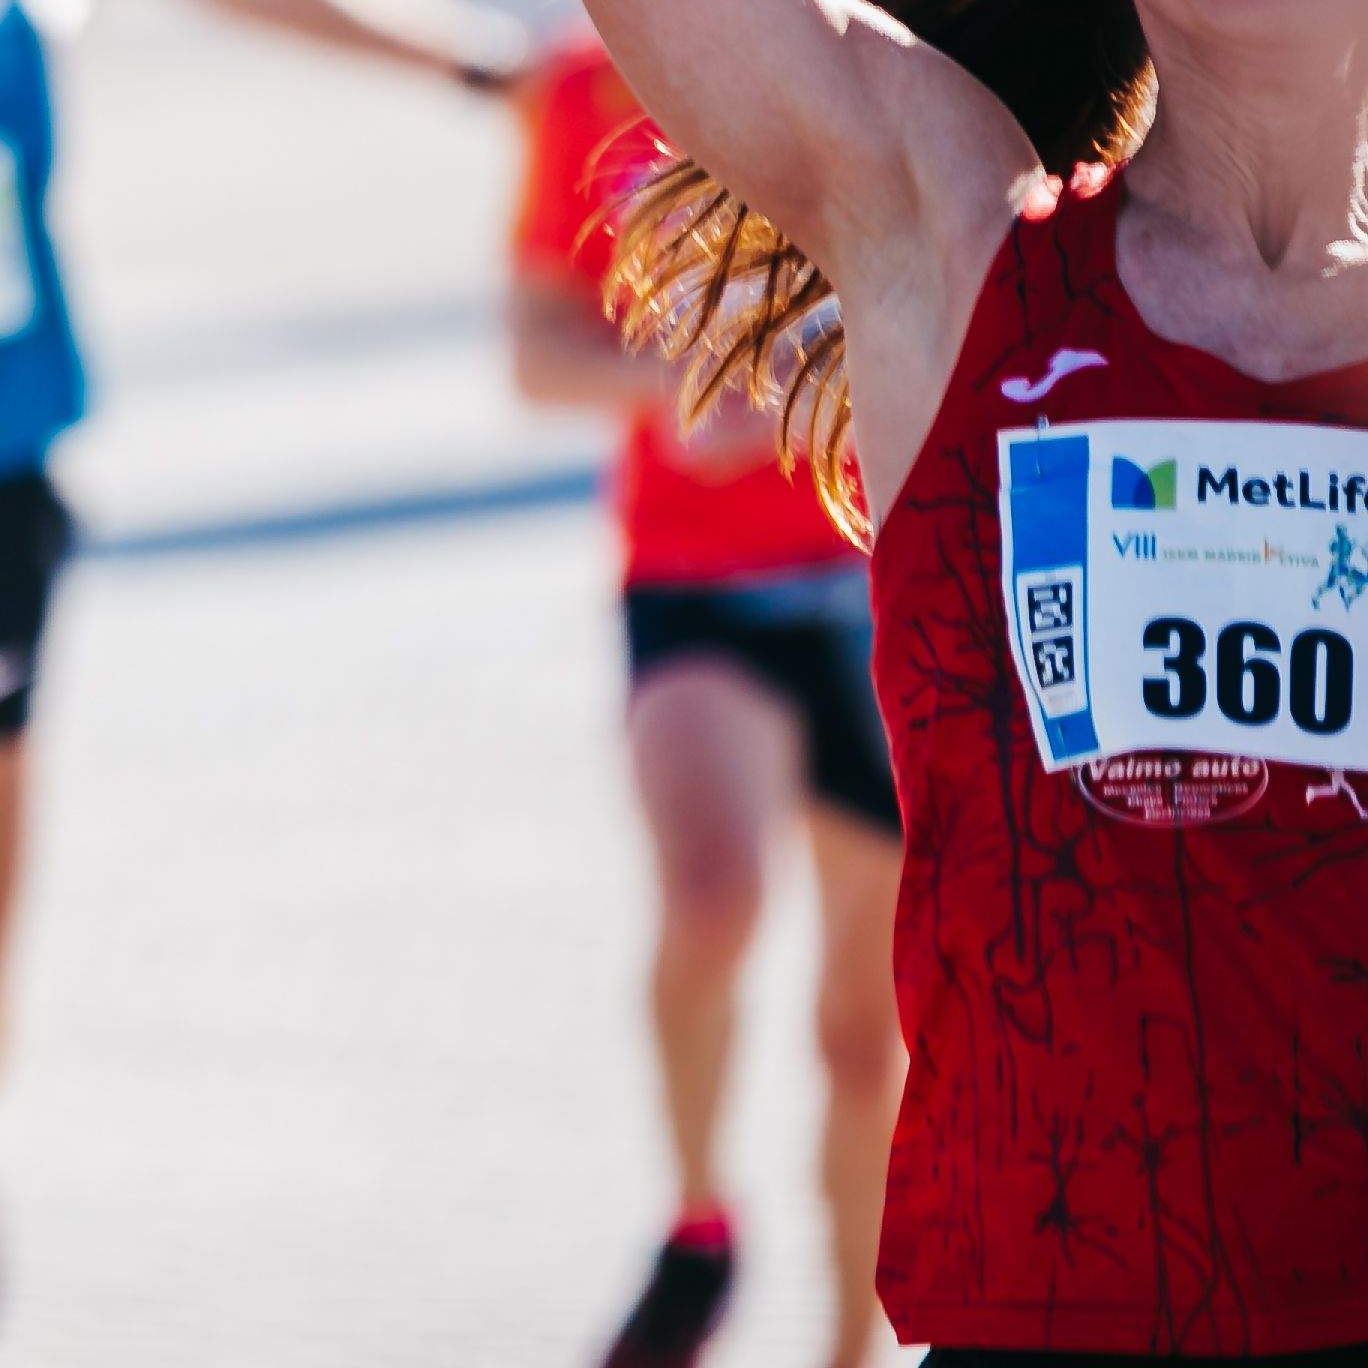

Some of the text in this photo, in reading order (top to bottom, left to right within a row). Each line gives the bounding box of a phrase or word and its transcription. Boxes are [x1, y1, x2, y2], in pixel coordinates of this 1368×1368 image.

[1197, 466, 1368, 513] MetLif
[1113, 531, 1156, 560] VIII
[1142, 616, 1354, 736] 360
[1192, 758, 1261, 779] auto
